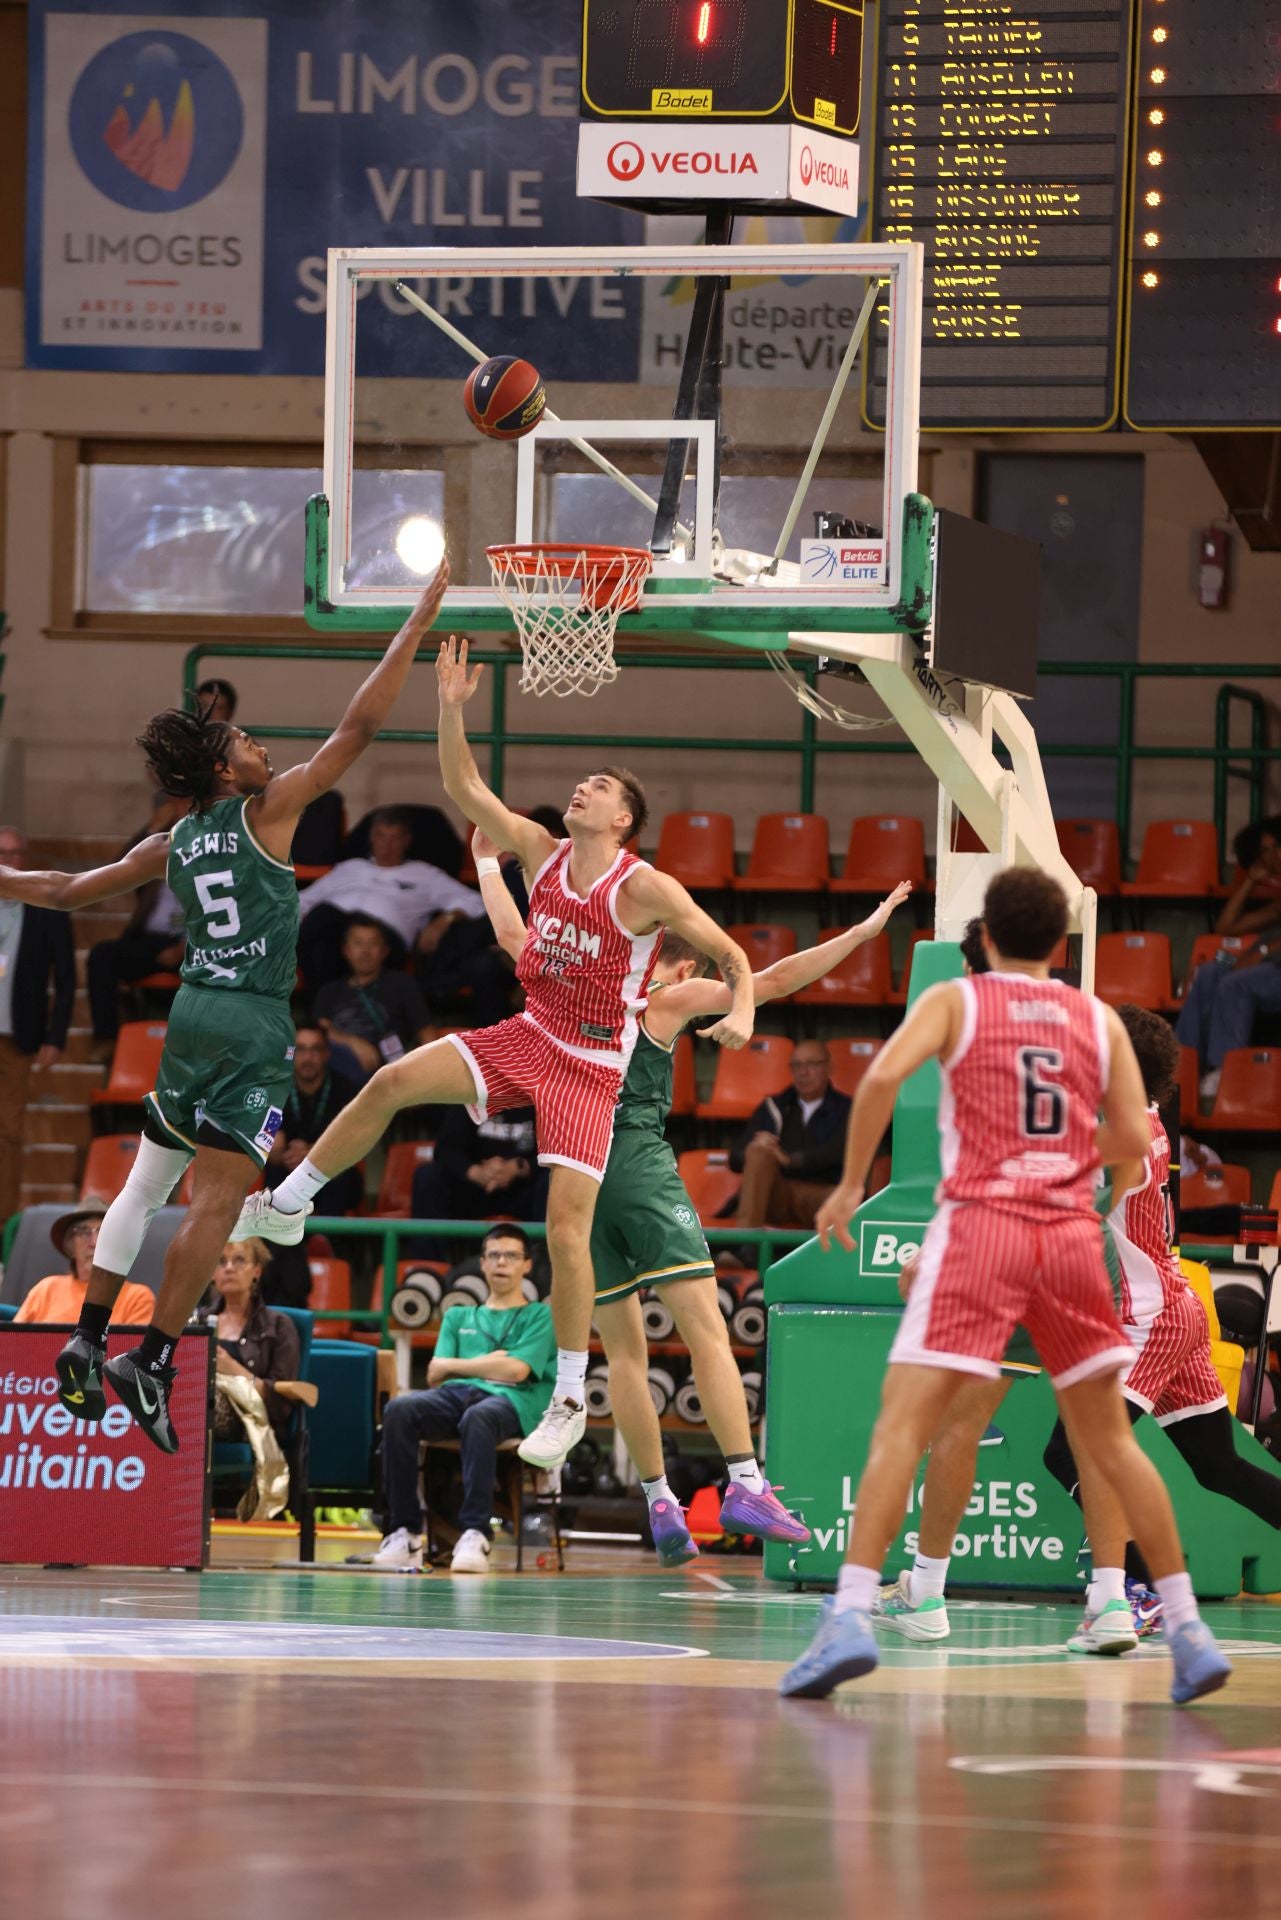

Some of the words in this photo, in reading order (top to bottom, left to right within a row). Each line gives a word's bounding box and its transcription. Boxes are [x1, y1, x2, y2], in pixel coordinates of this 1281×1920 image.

[296, 51, 579, 118] LIMOGE
[656, 92, 709, 109] Bodet
[816, 101, 835, 122] Bodet
[651, 152, 759, 175] VEOLIA
[814, 159, 849, 190] VEOLIA
[367, 168, 543, 227] VILLE
[64, 233, 242, 267] LIMOGES
[295, 255, 627, 319] SORTIVE
[80, 300, 134, 314] ARTS
[146, 301, 176, 315] DU
[186, 302, 227, 316] FEU
[730, 299, 862, 332] départe
[61, 317, 86, 331] ET
[99, 319, 243, 335] INNOVATION
[843, 551, 879, 562] Betclic
[843, 565, 878, 579] ÉLITE
[176, 832, 238, 867] LEWIS
[194, 869, 241, 939] 5
[532, 911, 601, 960] UCAM
[1017, 1045, 1068, 1140] 6
[904, 1524, 1064, 1560] sortive
